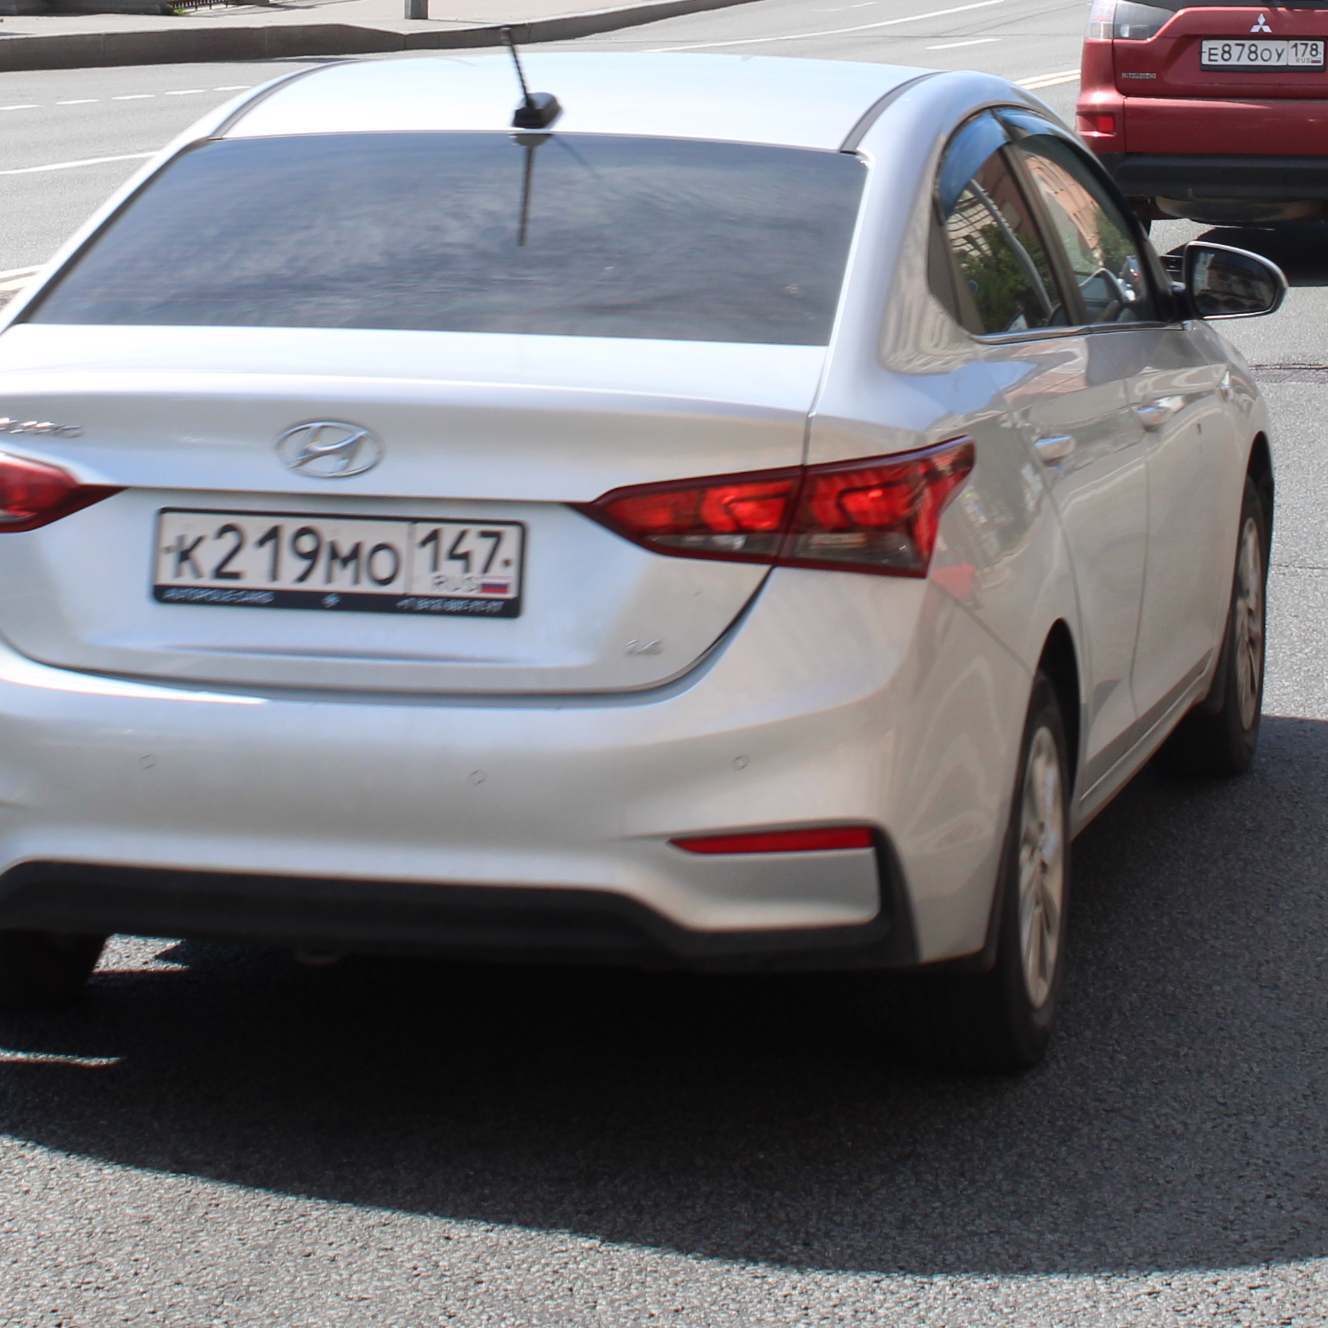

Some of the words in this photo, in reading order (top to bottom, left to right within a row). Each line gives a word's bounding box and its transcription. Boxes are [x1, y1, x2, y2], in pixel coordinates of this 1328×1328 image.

[1291, 43, 1319, 58] 178
[418, 527, 504, 575] 147
[433, 575, 480, 593] RUS
